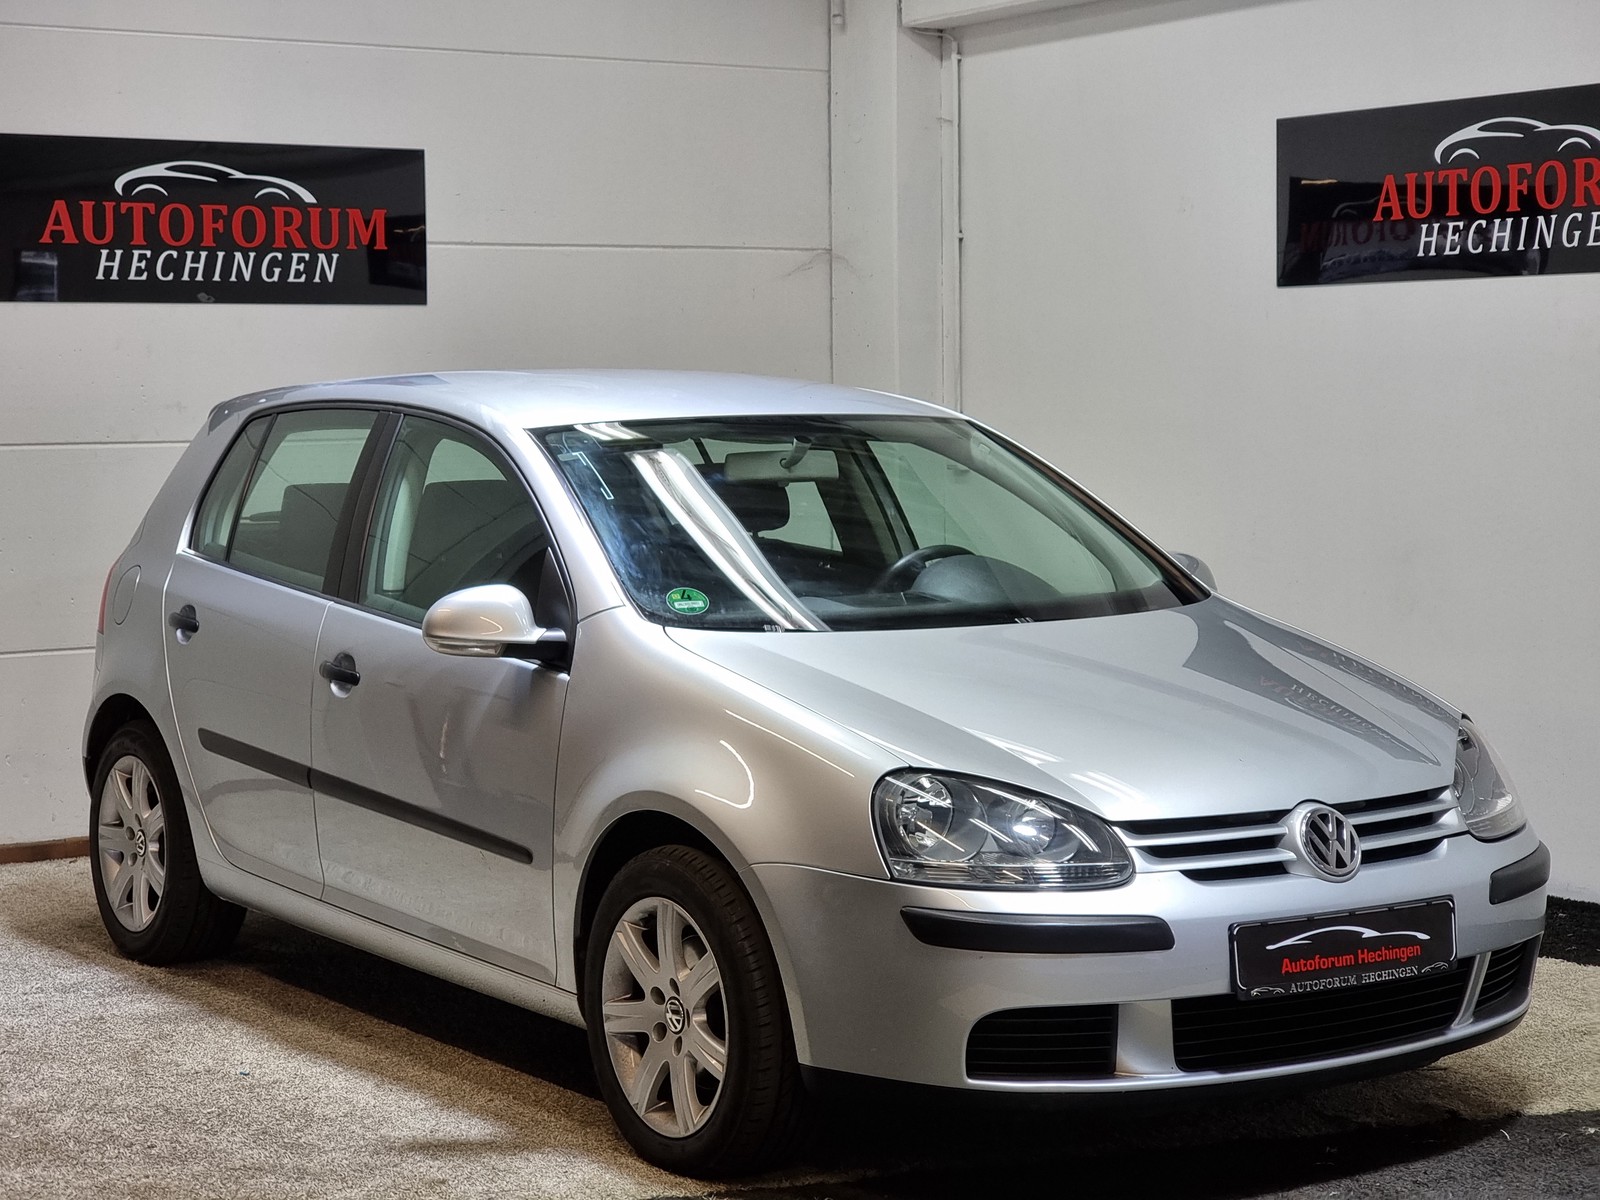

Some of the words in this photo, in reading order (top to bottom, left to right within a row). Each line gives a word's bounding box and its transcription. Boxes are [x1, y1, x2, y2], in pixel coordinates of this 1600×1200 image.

[1373, 157, 1600, 222] AUTOFOR
[38, 199, 388, 250] AUTOFORUM
[95, 249, 340, 283] HECHINGEN
[1281, 954, 1355, 975] Autoforum
[1357, 945, 1421, 963] Hechingen
[1289, 974, 1357, 993] AUTOFORUM
[1361, 965, 1419, 984] HECHINGEN
